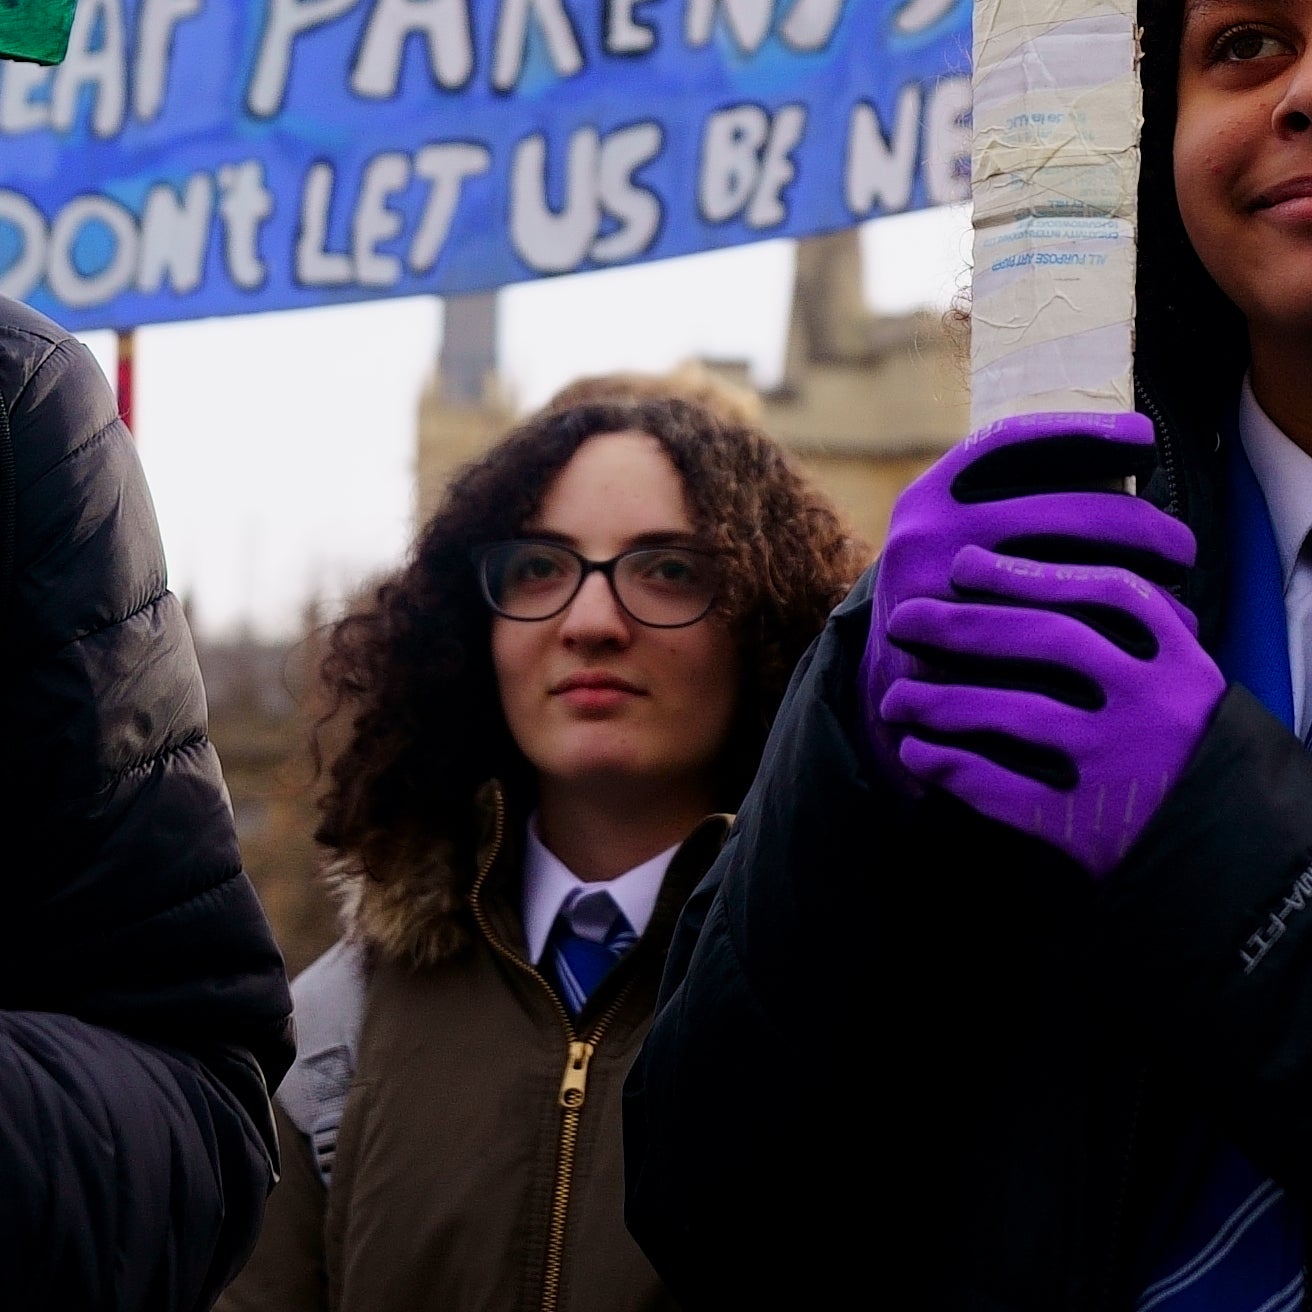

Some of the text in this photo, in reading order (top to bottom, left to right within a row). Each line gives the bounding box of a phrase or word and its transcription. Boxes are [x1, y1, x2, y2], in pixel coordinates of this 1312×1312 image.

[295, 139, 491, 289] LET
[510, 119, 665, 274] US
[700, 101, 806, 229] BE
[1035, 252, 1087, 265] PURPOSE
